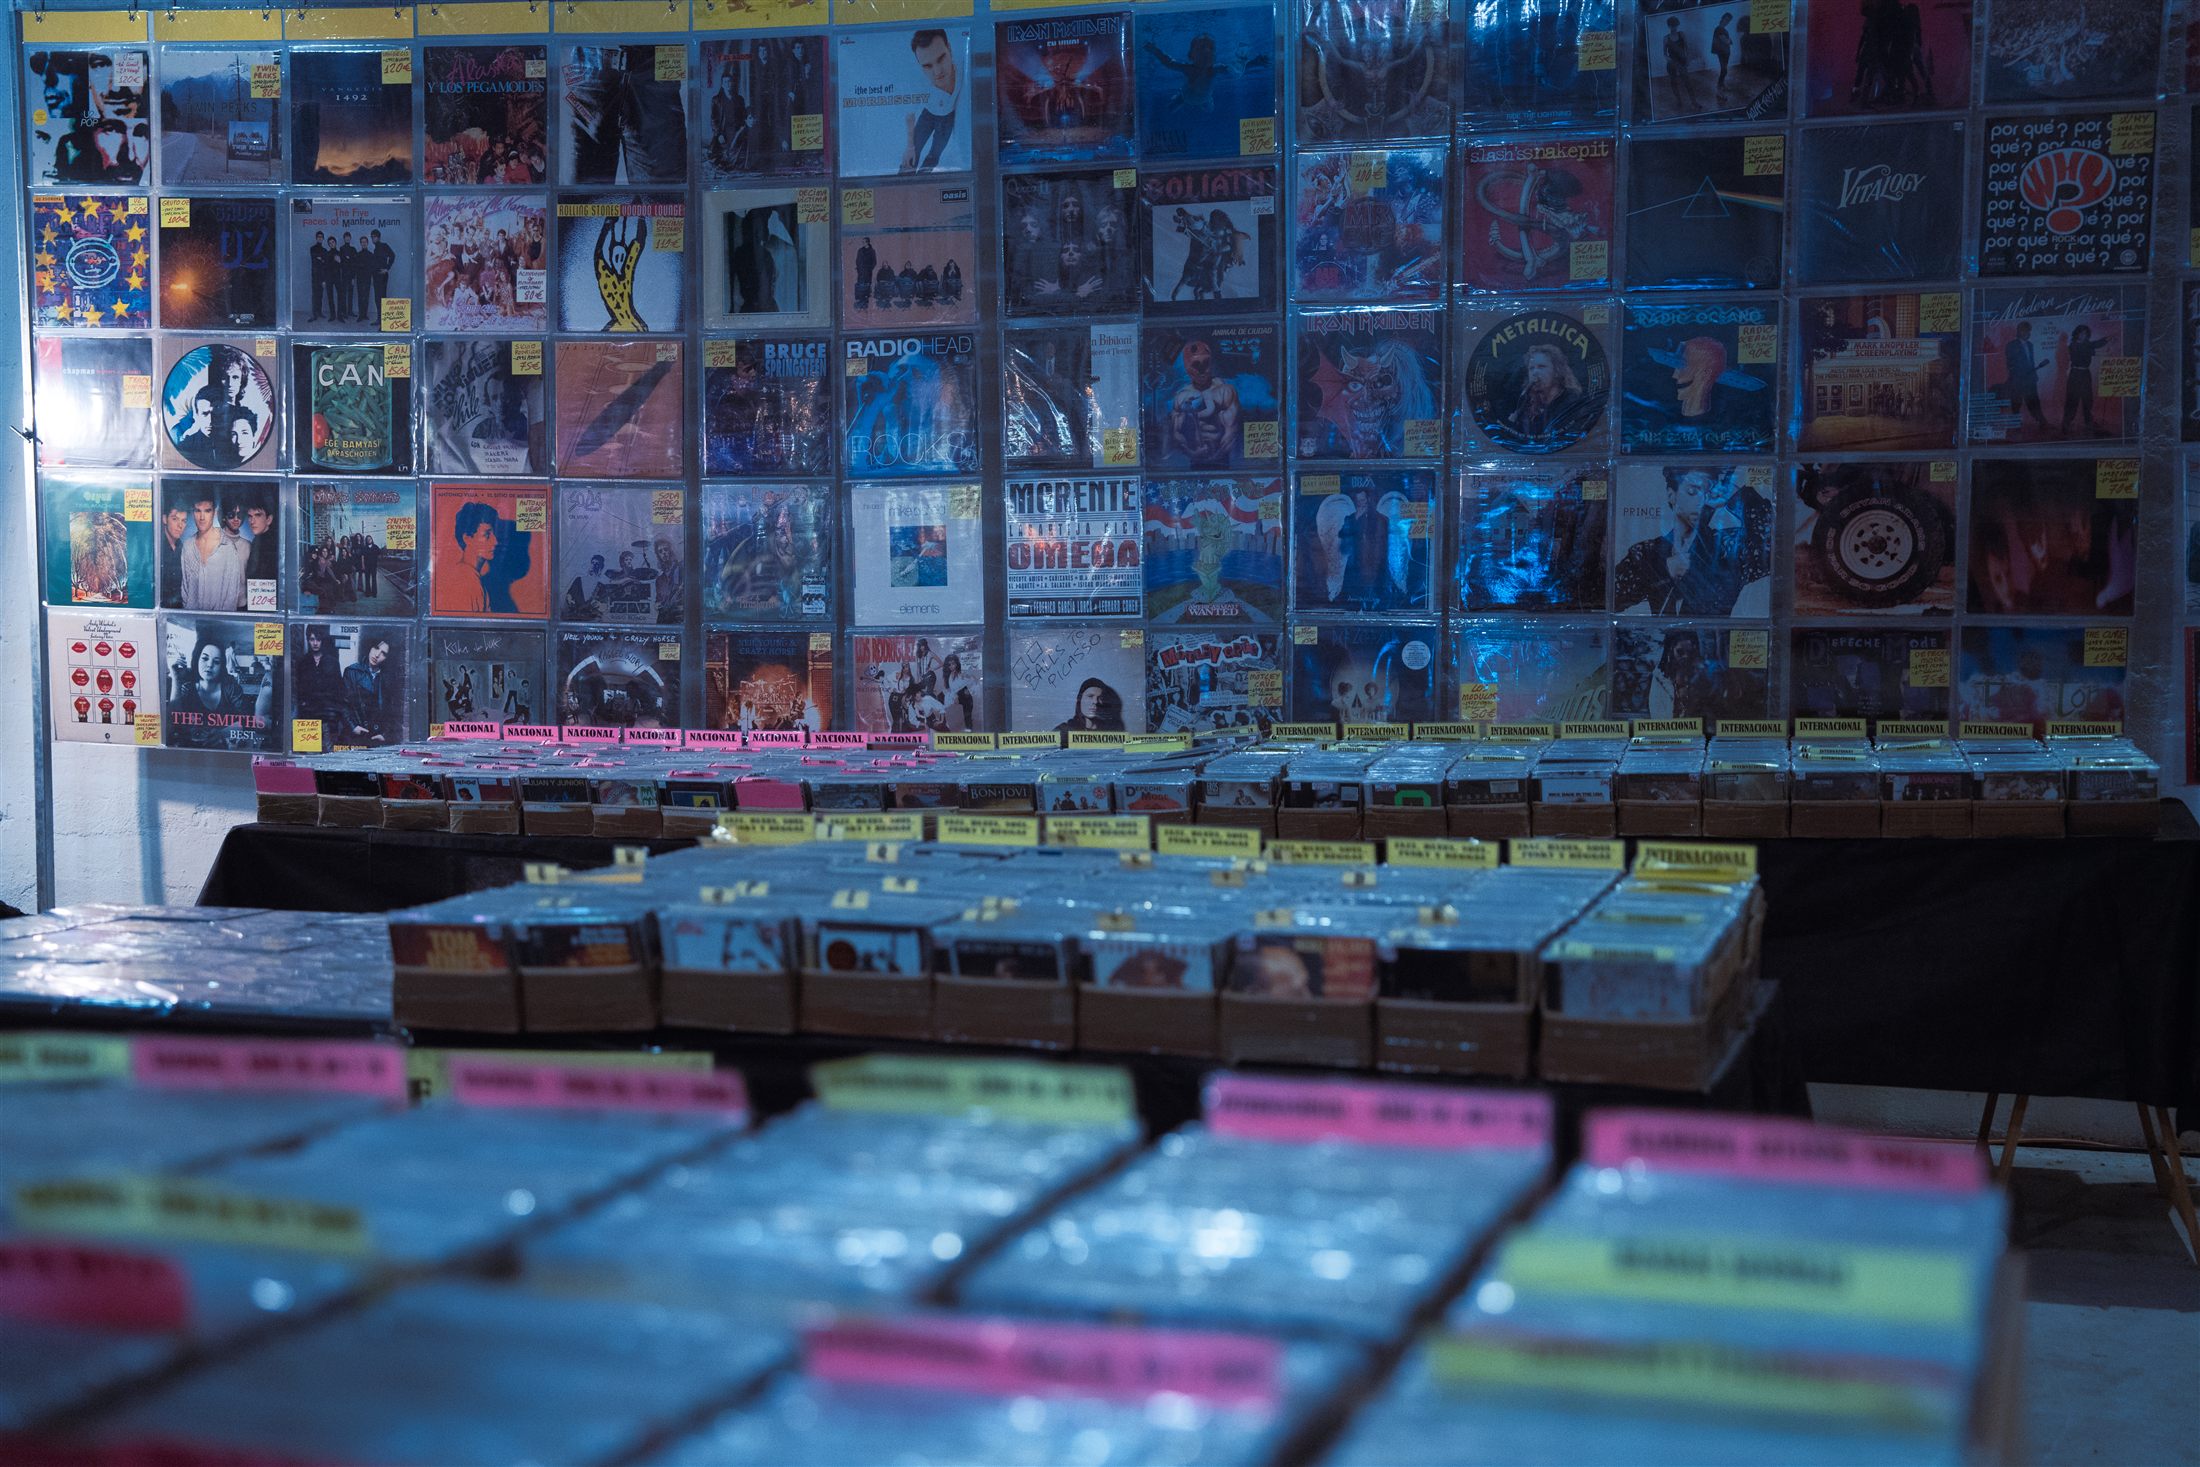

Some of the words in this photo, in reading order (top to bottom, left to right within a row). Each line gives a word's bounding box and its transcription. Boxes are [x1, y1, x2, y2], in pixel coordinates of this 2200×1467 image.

[1007, 21, 1051, 42] IRON
[1052, 17, 1120, 39] MAIDEN
[384, 63, 411, 73] 120€
[428, 82, 439, 93] Y
[440, 81, 463, 93] LOS
[467, 80, 545, 92] PEGAMOIDES
[842, 93, 930, 107] MORRISSEY
[221, 102, 257, 112] PEAKS
[80, 119, 98, 127] POP
[1991, 125, 2018, 140] por
[1989, 162, 2016, 178] por
[1836, 164, 1928, 210] VITALOGY
[1988, 177, 2018, 196] qué
[2119, 176, 2147, 192] por
[844, 190, 872, 201] OASIS
[943, 191, 967, 200] oasis
[334, 208, 349, 218] The
[352, 208, 369, 217] Five
[558, 205, 589, 217] ROLLING
[591, 205, 619, 216] STONES
[622, 205, 652, 216] VOODOO
[654, 204, 683, 216] LOUNGE
[1987, 201, 2015, 217] por
[302, 217, 328, 228] Faces
[330, 217, 340, 226] of
[342, 217, 376, 228] Manfred
[378, 217, 401, 228] Mann
[2117, 213, 2144, 228] por
[1985, 237, 2012, 252] por
[2032, 253, 2060, 269] por
[1989, 294, 2055, 328] Modern
[2055, 293, 2116, 318] Talking
[1307, 312, 1354, 335] IRON
[1359, 310, 1435, 336] MAIDEN
[1212, 328, 1237, 336] ANIMAL
[1248, 327, 1272, 335] CIUDAD
[1490, 318, 1590, 360] METALLICA
[387, 346, 408, 355] CAN
[764, 343, 826, 359] BRUCE
[847, 336, 972, 358] RADIOHEAD
[520, 360, 540, 371] 75€
[712, 354, 735, 366] 80€
[63, 367, 95, 375] chapman
[764, 359, 826, 377] SPRINGSTEEN
[318, 363, 384, 387] CAN
[1248, 423, 1274, 431] EVO
[324, 439, 338, 447] EGE
[342, 439, 380, 450] BAMYASI
[659, 492, 679, 500] SODA
[1009, 480, 1136, 515] MORENTE
[1623, 507, 1661, 517] PRINCE
[395, 540, 415, 548] 75€
[1008, 539, 1139, 570] OMEGA
[251, 595, 276, 606] 120€
[900, 602, 940, 614] elements
[1188, 608, 1239, 616] WANTED
[624, 635, 650, 645] CRAZY
[653, 634, 677, 643] HORSE
[258, 640, 284, 651] 160€
[1048, 633, 1101, 688] PICASSO
[1471, 709, 1496, 719] 50€
[172, 711, 204, 726] THE
[207, 713, 265, 729] SMITHS
[449, 723, 495, 733] NACIONAL
[1275, 725, 1332, 736] INTERNACIONAL
[1347, 726, 1405, 736] INTERNACIONAL
[1417, 725, 1475, 735] INTERNACIONAL
[1491, 726, 1549, 736] INTERNACIONAL
[1565, 723, 1624, 734] INTERNACIONAL
[1637, 721, 1699, 736] INTERNACIONAL
[1721, 723, 1782, 733] INTERNACIONAL
[1799, 721, 1862, 732] INTERNACIONAL
[1881, 724, 1945, 734] INTERNACIONAL
[1964, 725, 2028, 736] INTERNACIONAL
[2051, 724, 2116, 734] INTERNACIONAL
[300, 733, 320, 742] 50€
[508, 728, 554, 737] NACIONAL
[567, 728, 615, 738] NACIONAL
[629, 730, 677, 740] NACIONAL
[690, 732, 737, 742] NACIONAL
[752, 733, 800, 742] NACIONAL
[814, 734, 864, 744] NACIONAL
[874, 735, 922, 743] NACIONAL
[937, 735, 991, 745] INTERNACIONAL
[1002, 735, 1056, 745] INTERNACIONAL
[970, 788, 997, 800] BON
[999, 787, 1028, 799] JOVI
